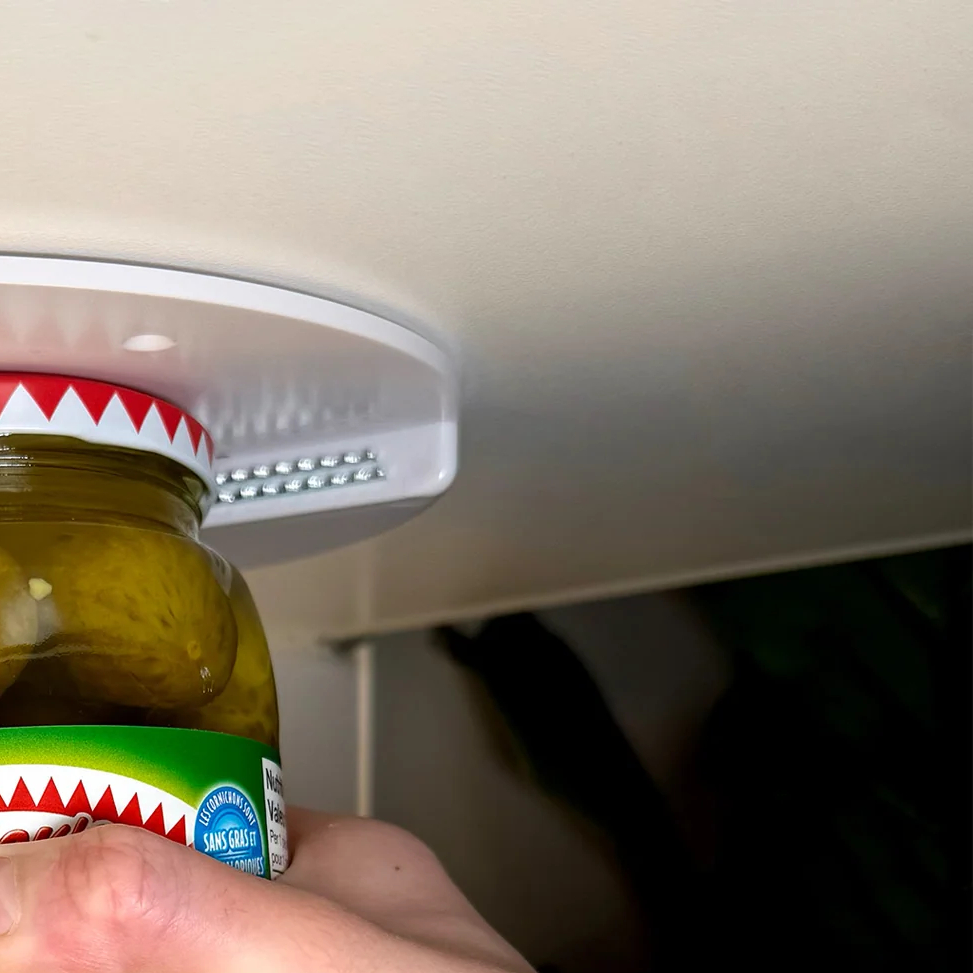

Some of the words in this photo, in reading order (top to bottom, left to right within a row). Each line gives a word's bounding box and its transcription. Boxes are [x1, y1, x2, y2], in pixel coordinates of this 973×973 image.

[199, 808, 211, 826] LES
[206, 791, 244, 812] CORNICHONS
[242, 802, 256, 826] SONT
[203, 830, 227, 852] SANS
[228, 829, 249, 849] GRAS
[249, 831, 257, 847] ET
